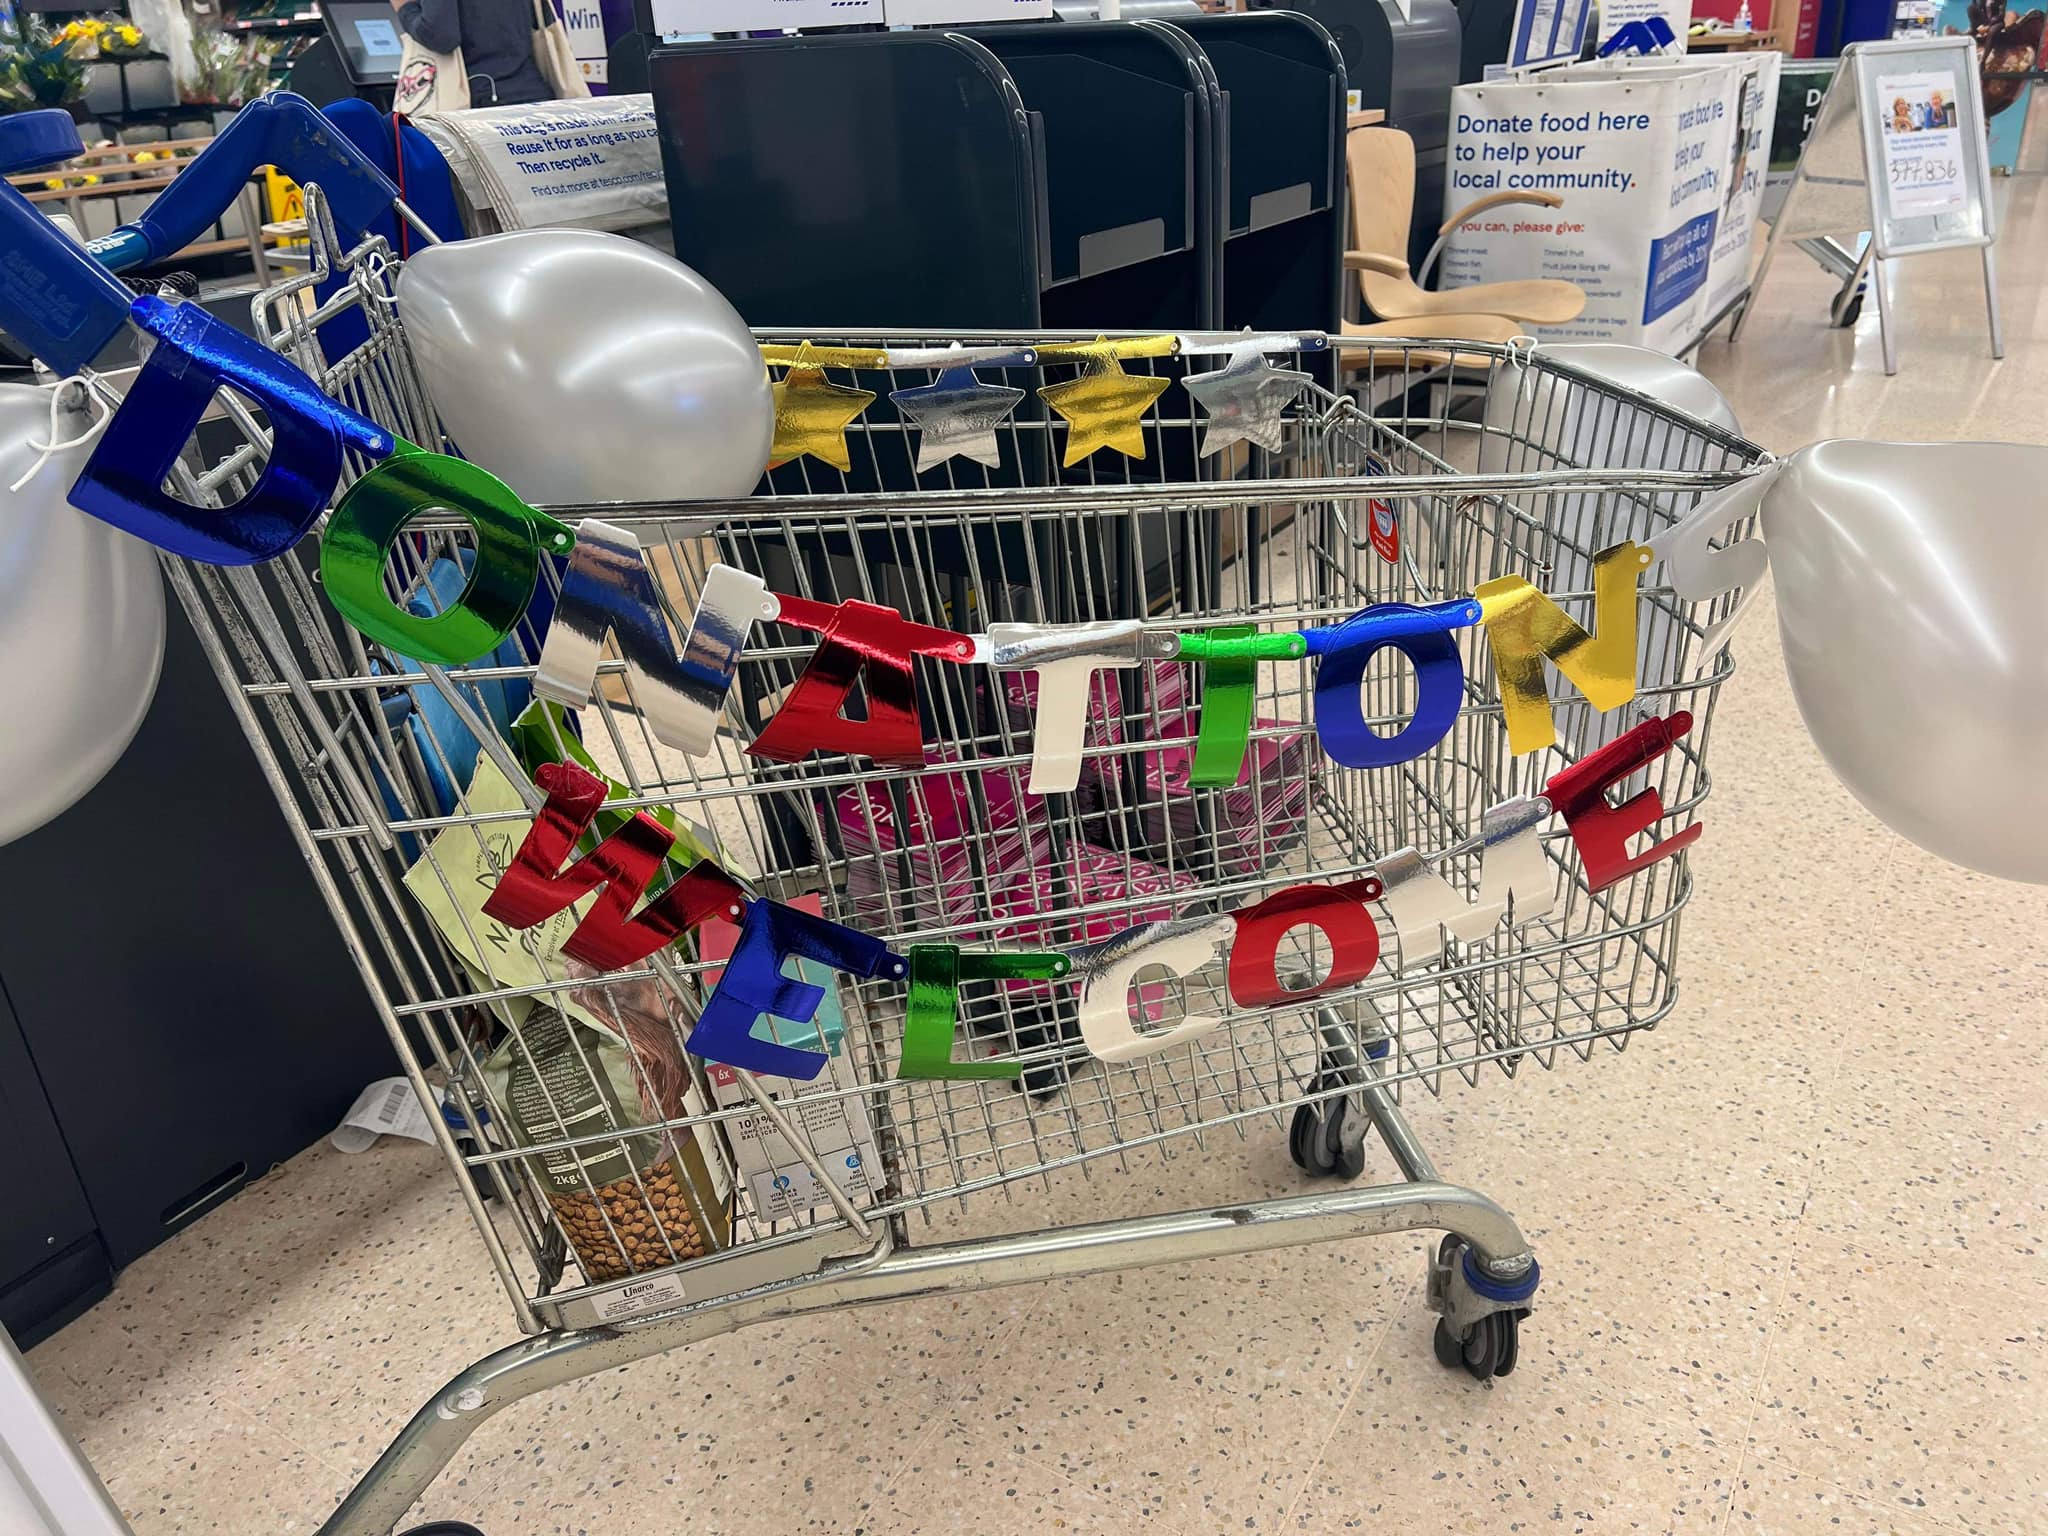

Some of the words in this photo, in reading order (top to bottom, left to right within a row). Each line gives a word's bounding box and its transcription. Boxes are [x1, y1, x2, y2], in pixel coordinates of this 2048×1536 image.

[566, 8, 600, 30] Win
[1457, 114, 1533, 134] Donate
[1538, 111, 1590, 132] food
[1597, 111, 1650, 131] here
[505, 141, 545, 156] Reuse
[545, 138, 556, 153] it
[554, 137, 575, 151] for
[575, 136, 590, 148] as
[588, 131, 616, 147] long
[614, 130, 627, 143] as
[627, 128, 647, 145] you
[646, 127, 660, 138] ca
[1455, 143, 1476, 161] to
[1481, 141, 1530, 166] help
[1535, 144, 1586, 165] your
[516, 159, 550, 175] Then
[550, 154, 592, 173] recycle
[530, 184, 553, 198] Find
[552, 182, 569, 195] out
[567, 179, 592, 193] more
[1452, 169, 1502, 189] local
[1507, 168, 1637, 193] community.
[1512, 221, 1553, 235] please
[1555, 221, 1585, 236] give:
[481, 711, 1704, 1081] WELCOME
[646, 886, 666, 902] UIDE
[718, 1068, 731, 1081] 6x
[553, 1173, 579, 1186] 2kg
[622, 1282, 655, 1298] Unarco
